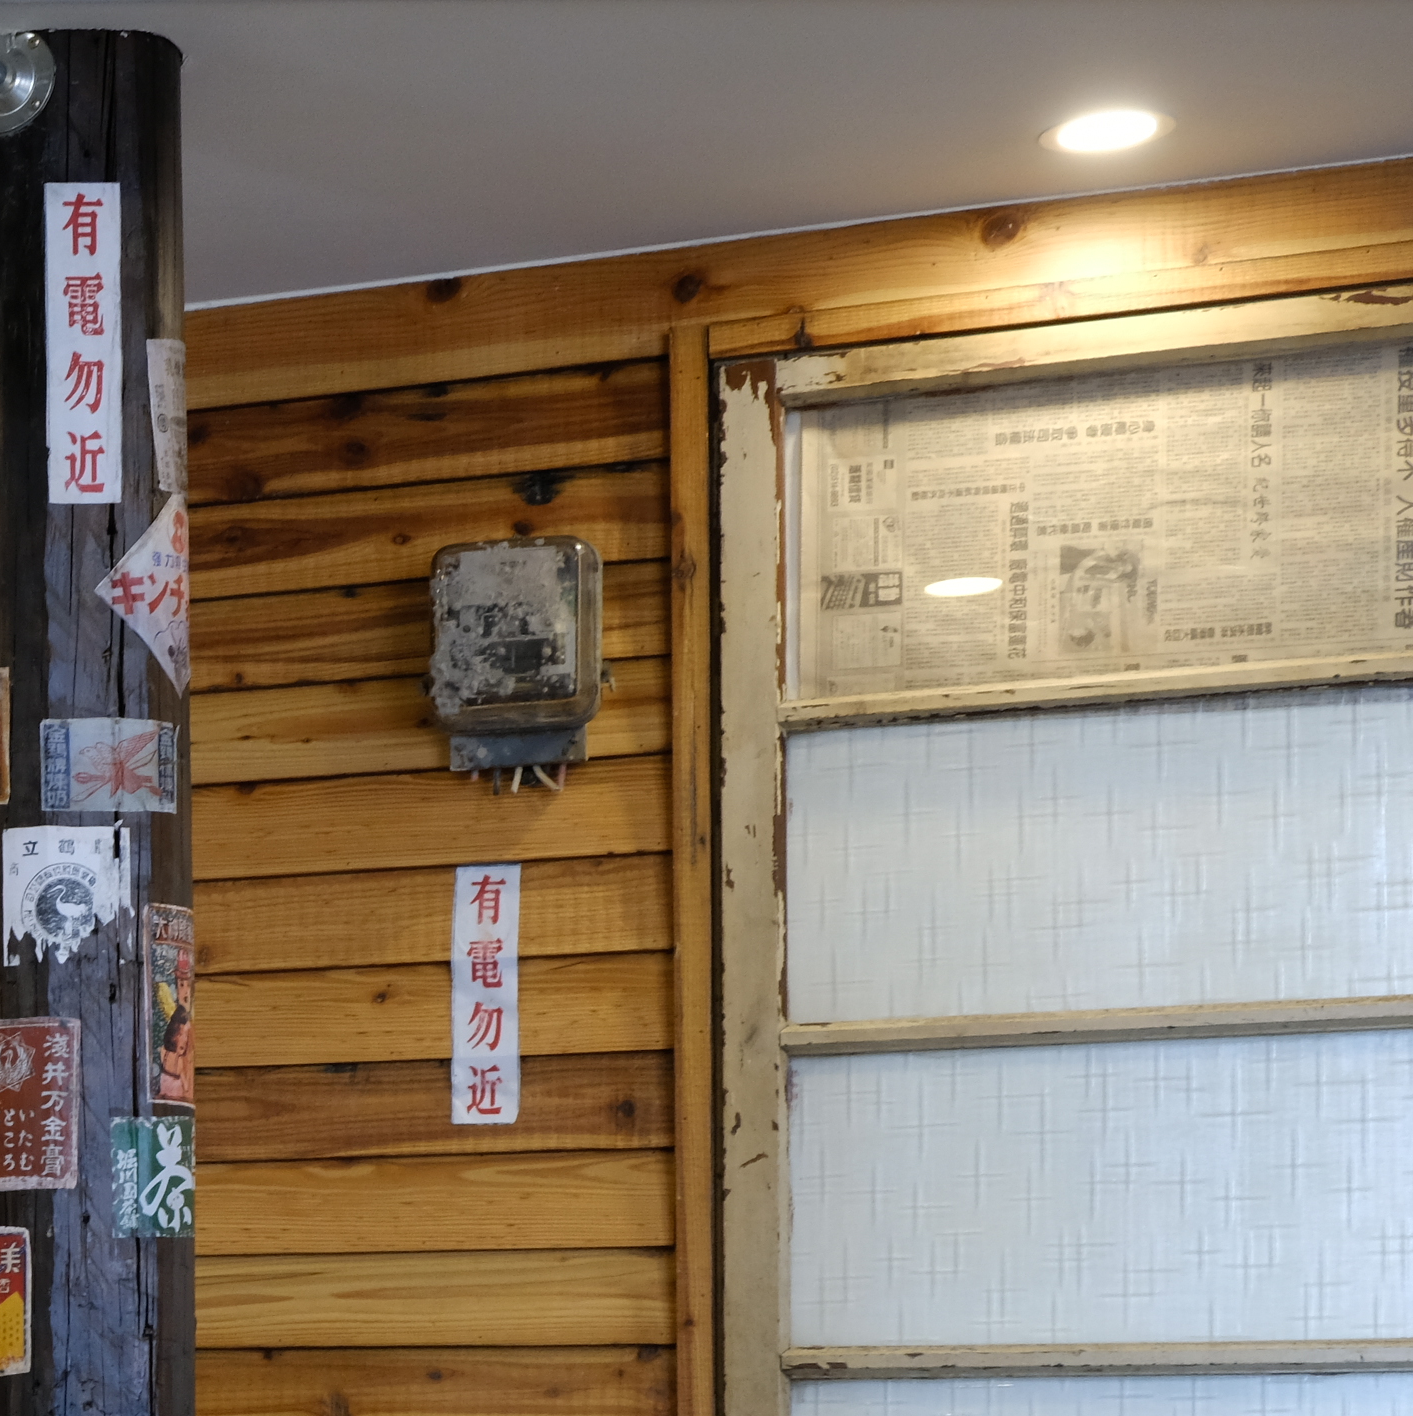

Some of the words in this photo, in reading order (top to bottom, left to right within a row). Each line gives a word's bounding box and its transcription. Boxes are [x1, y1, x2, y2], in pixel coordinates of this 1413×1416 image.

[62, 192, 105, 493] 有電勿近
[111, 572, 188, 618] キンチ
[467, 874, 507, 1116] 有電勿近
[3, 1108, 16, 1171] ところ
[18, 1109, 35, 1171] いたむ
[40, 1032, 70, 1177] 淺井万金膏
[141, 1122, 193, 1233] 茶
